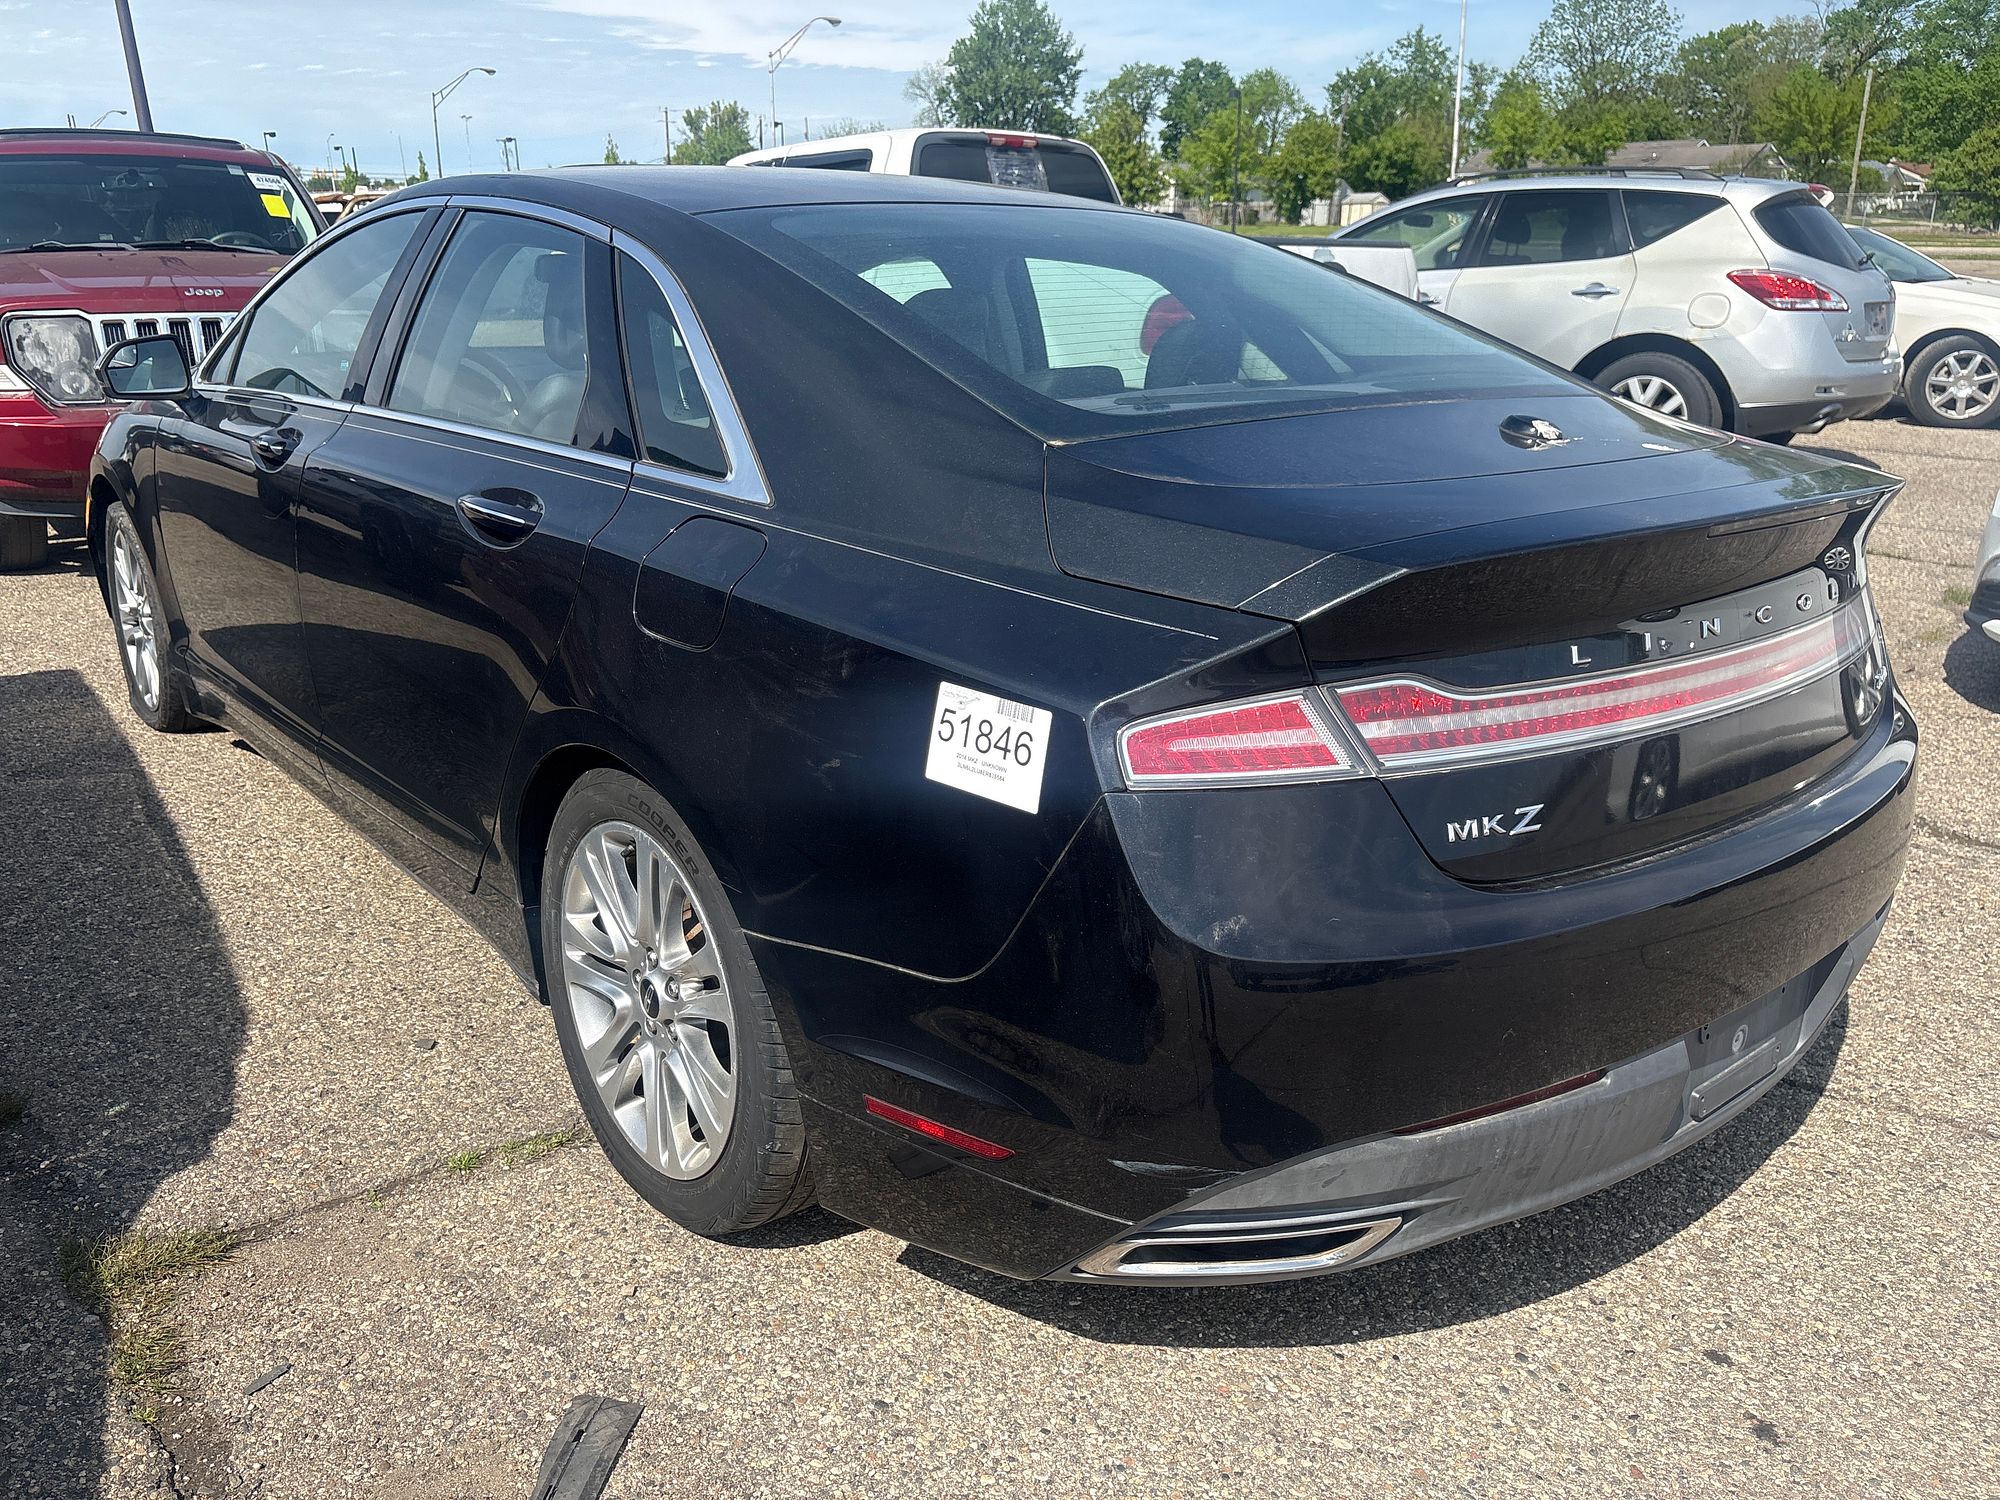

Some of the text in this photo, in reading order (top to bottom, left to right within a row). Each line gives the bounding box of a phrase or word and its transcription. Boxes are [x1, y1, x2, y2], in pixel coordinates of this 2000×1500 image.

[184, 287, 225, 297] Jeep
[938, 708, 1033, 766] 51846
[981, 760, 1008, 774] UNKNOWN
[627, 793, 700, 876] COOPER
[1446, 803, 1544, 843] MKZ
